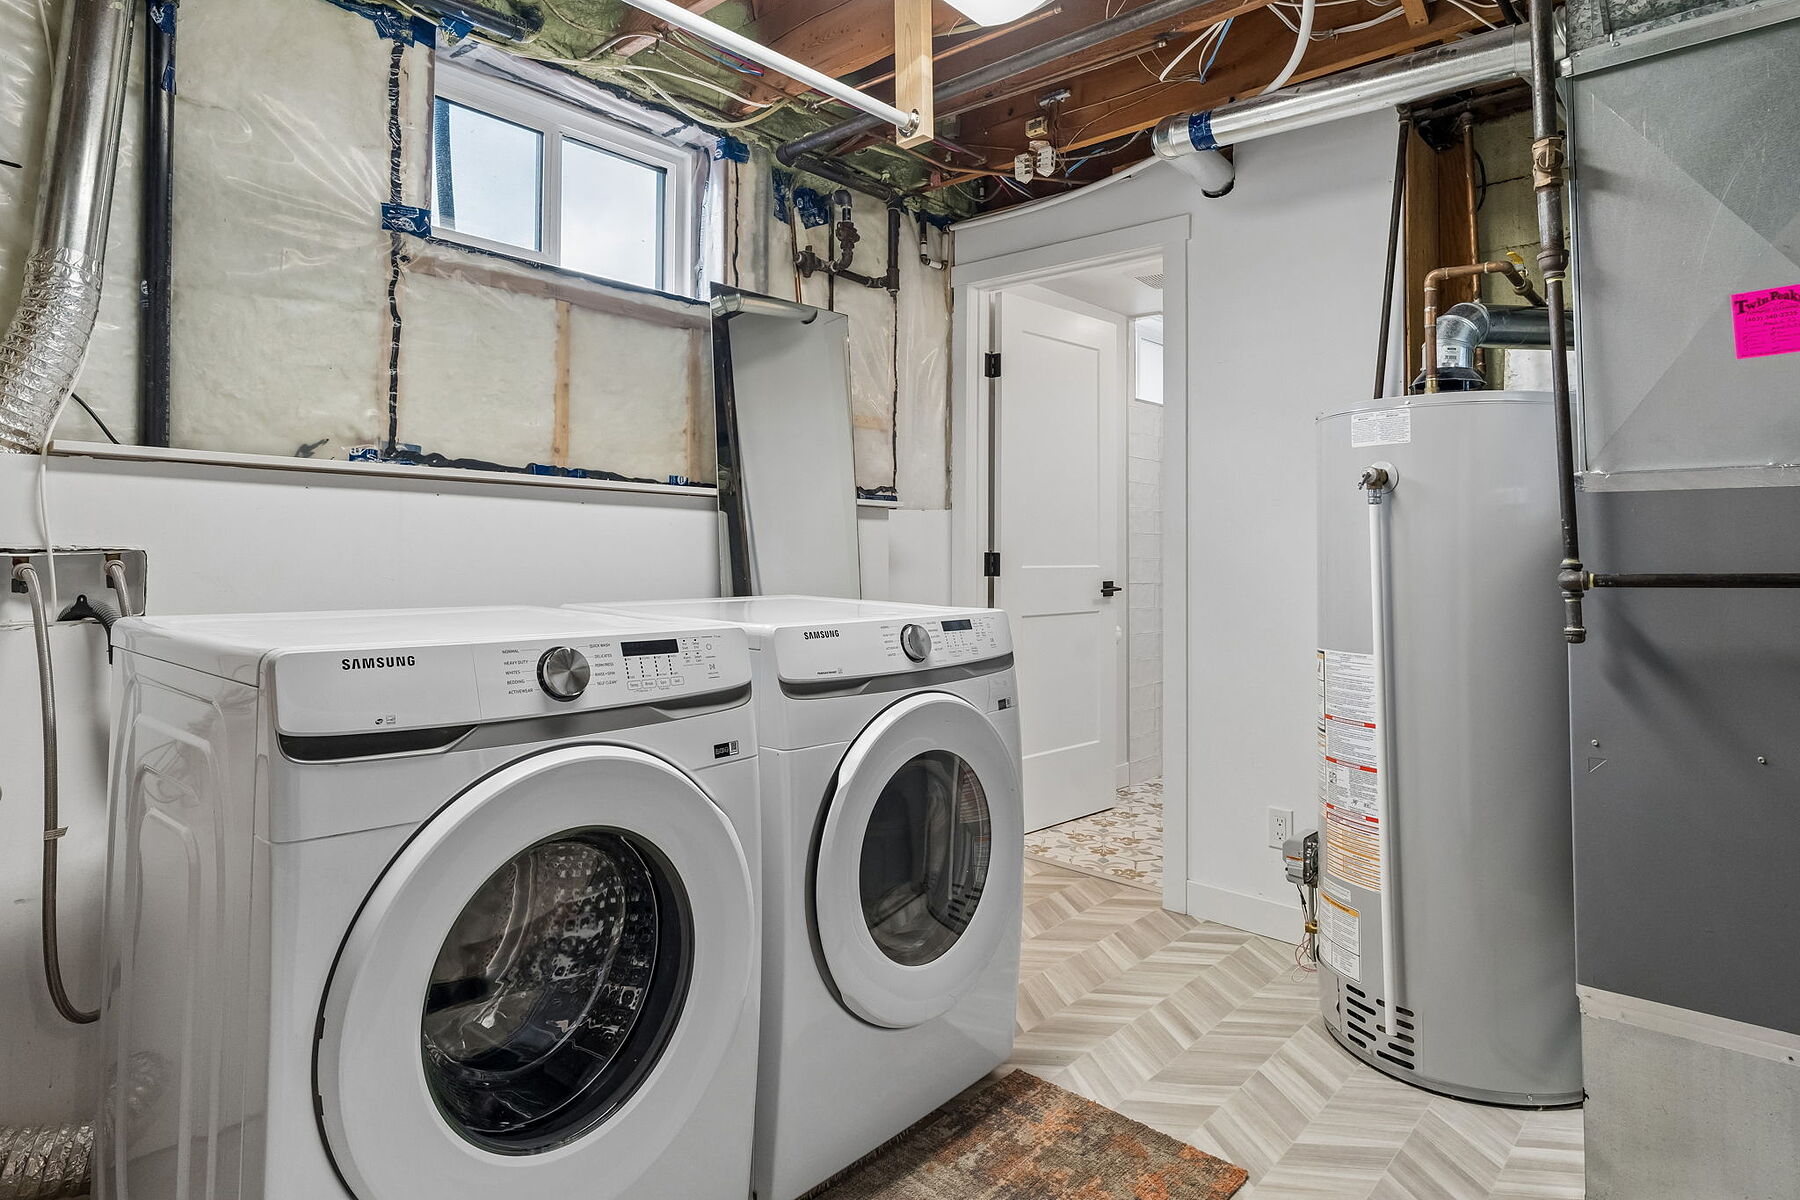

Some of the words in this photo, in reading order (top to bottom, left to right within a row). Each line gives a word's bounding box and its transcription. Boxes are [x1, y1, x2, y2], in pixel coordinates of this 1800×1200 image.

[1734, 297, 1769, 315] Twin
[803, 629, 840, 640] SAMSUNG
[341, 655, 416, 671] SAMSUNG
